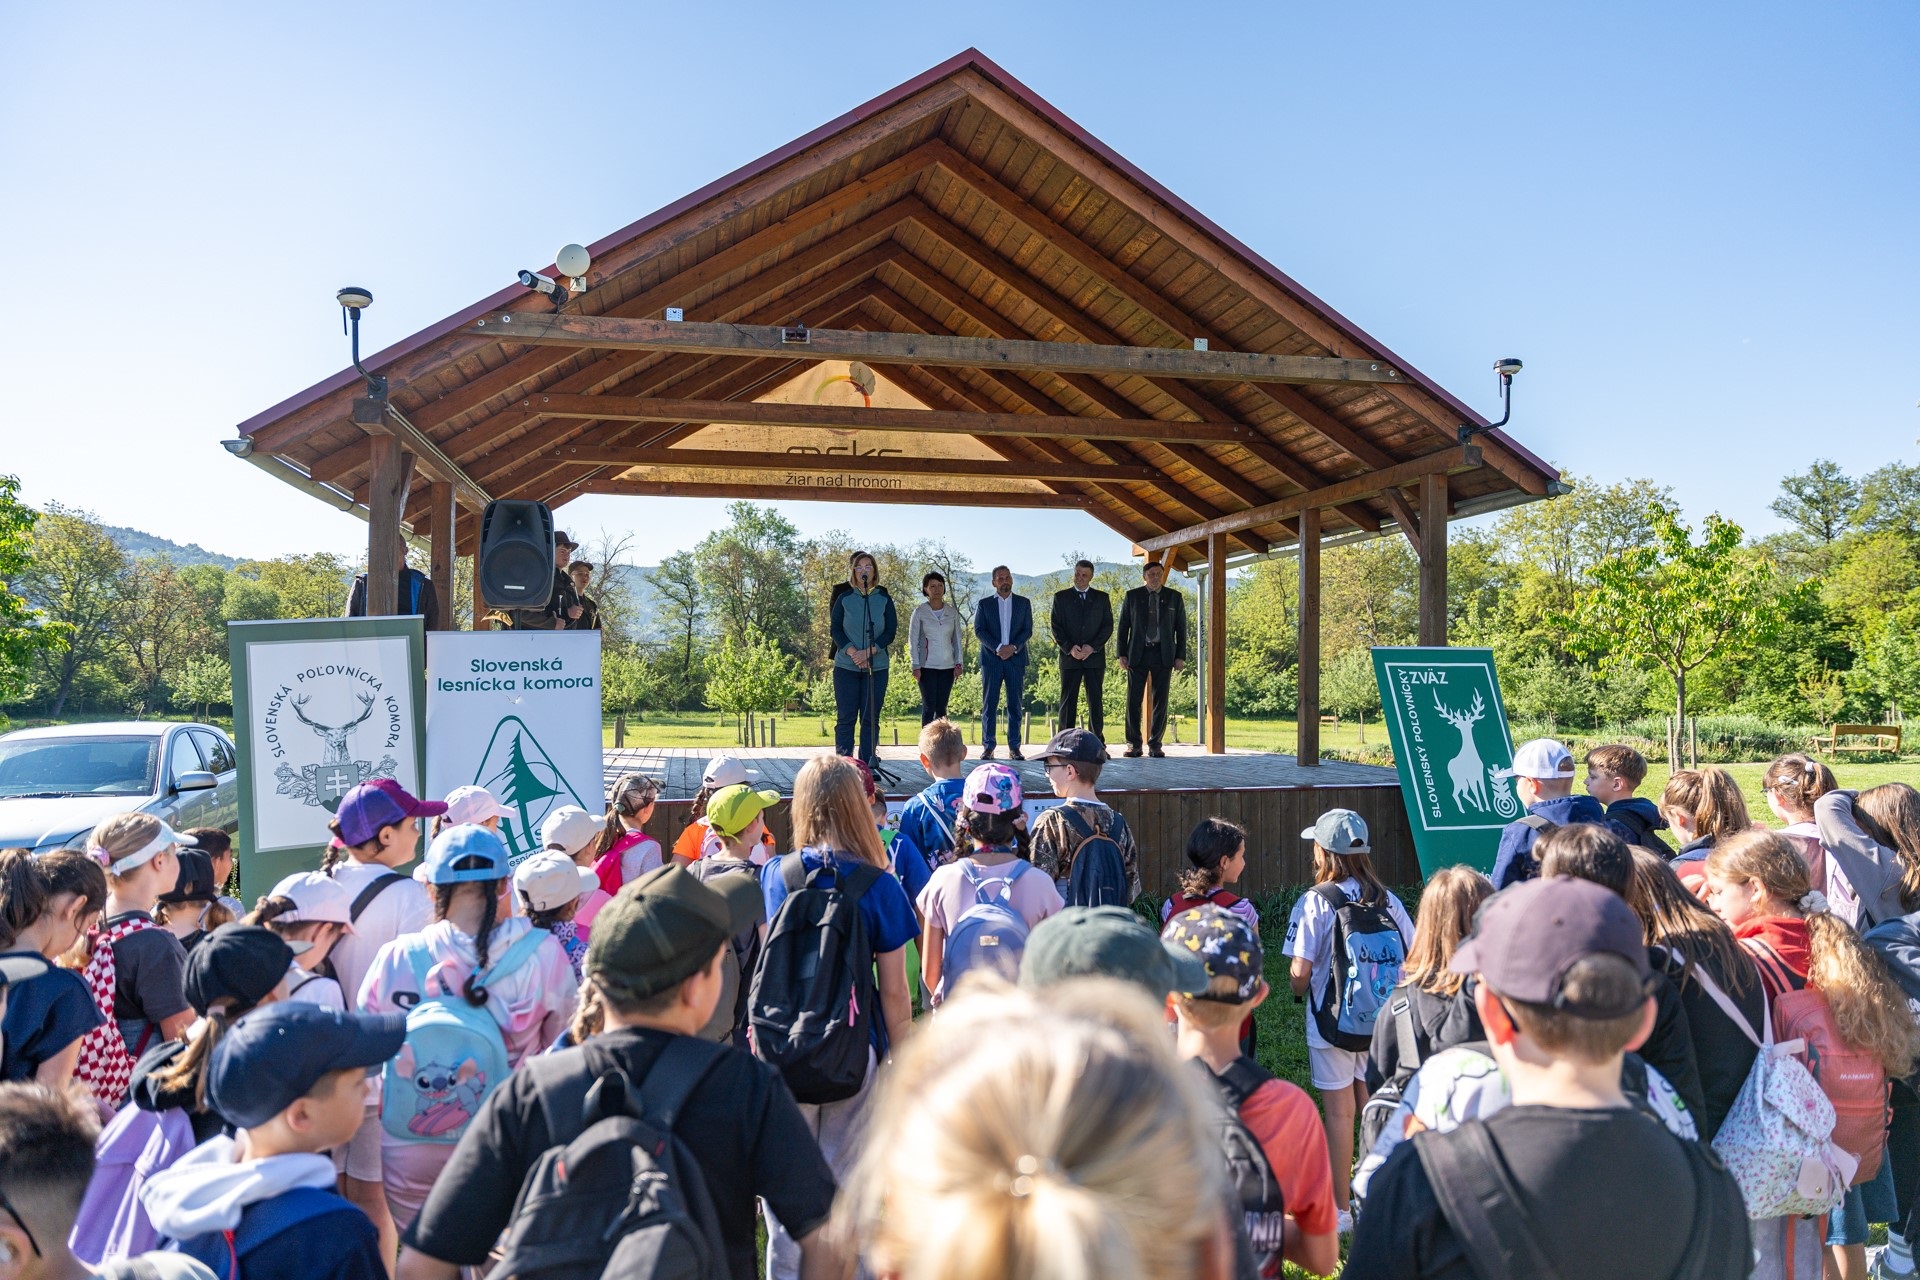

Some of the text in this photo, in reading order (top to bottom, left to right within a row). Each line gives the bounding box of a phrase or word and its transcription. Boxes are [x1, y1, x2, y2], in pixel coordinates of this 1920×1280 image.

[785, 472, 902, 488] žiar nad hronom
[470, 656, 563, 673] Slovenská
[437, 676, 594, 692] lesnícka komora
[1408, 668, 1449, 684] ZVÄZ
[264, 665, 401, 758] SLOVENSKÁ POĽOVNÍCKA KOMORA
[1415, 745, 1442, 818] SLOVENSKÝ
